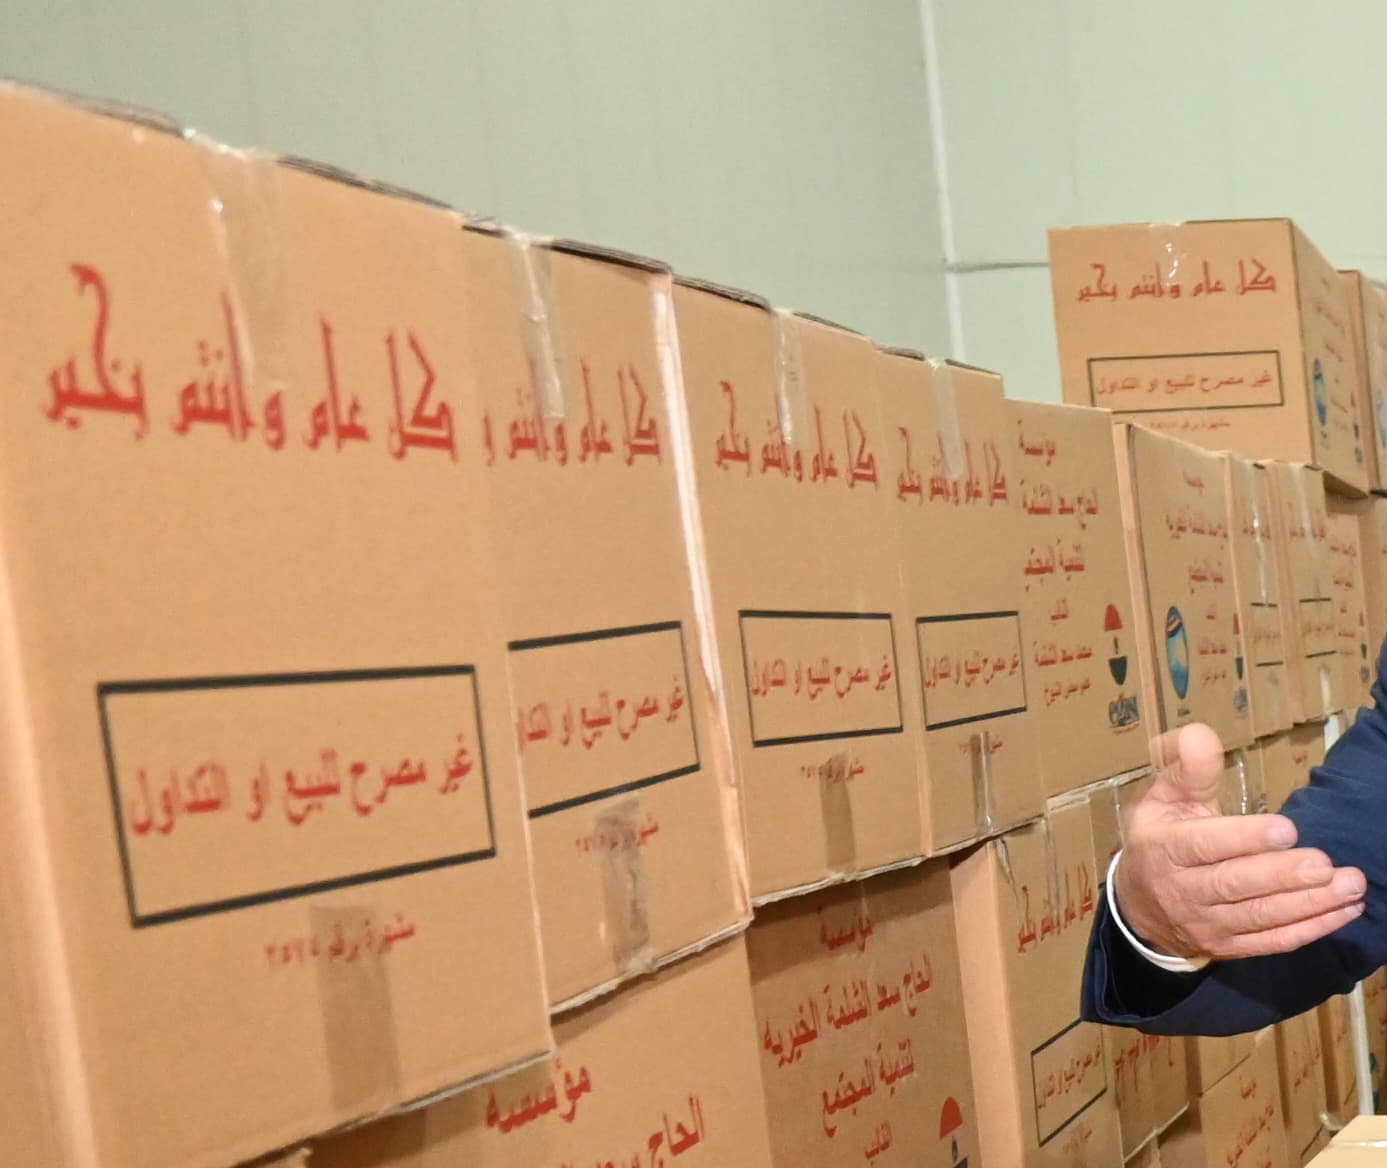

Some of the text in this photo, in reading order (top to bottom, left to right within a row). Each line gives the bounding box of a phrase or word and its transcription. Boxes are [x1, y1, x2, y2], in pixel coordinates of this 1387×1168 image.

[1192, 260, 1226, 296] عام
[1235, 258, 1277, 295] كل
[40, 260, 149, 442] بخير
[304, 312, 371, 453] عام
[388, 325, 457, 465] كل
[577, 356, 613, 465] عام
[617, 360, 663, 466] كل
[812, 402, 838, 482] عام
[843, 407, 879, 493] كل
